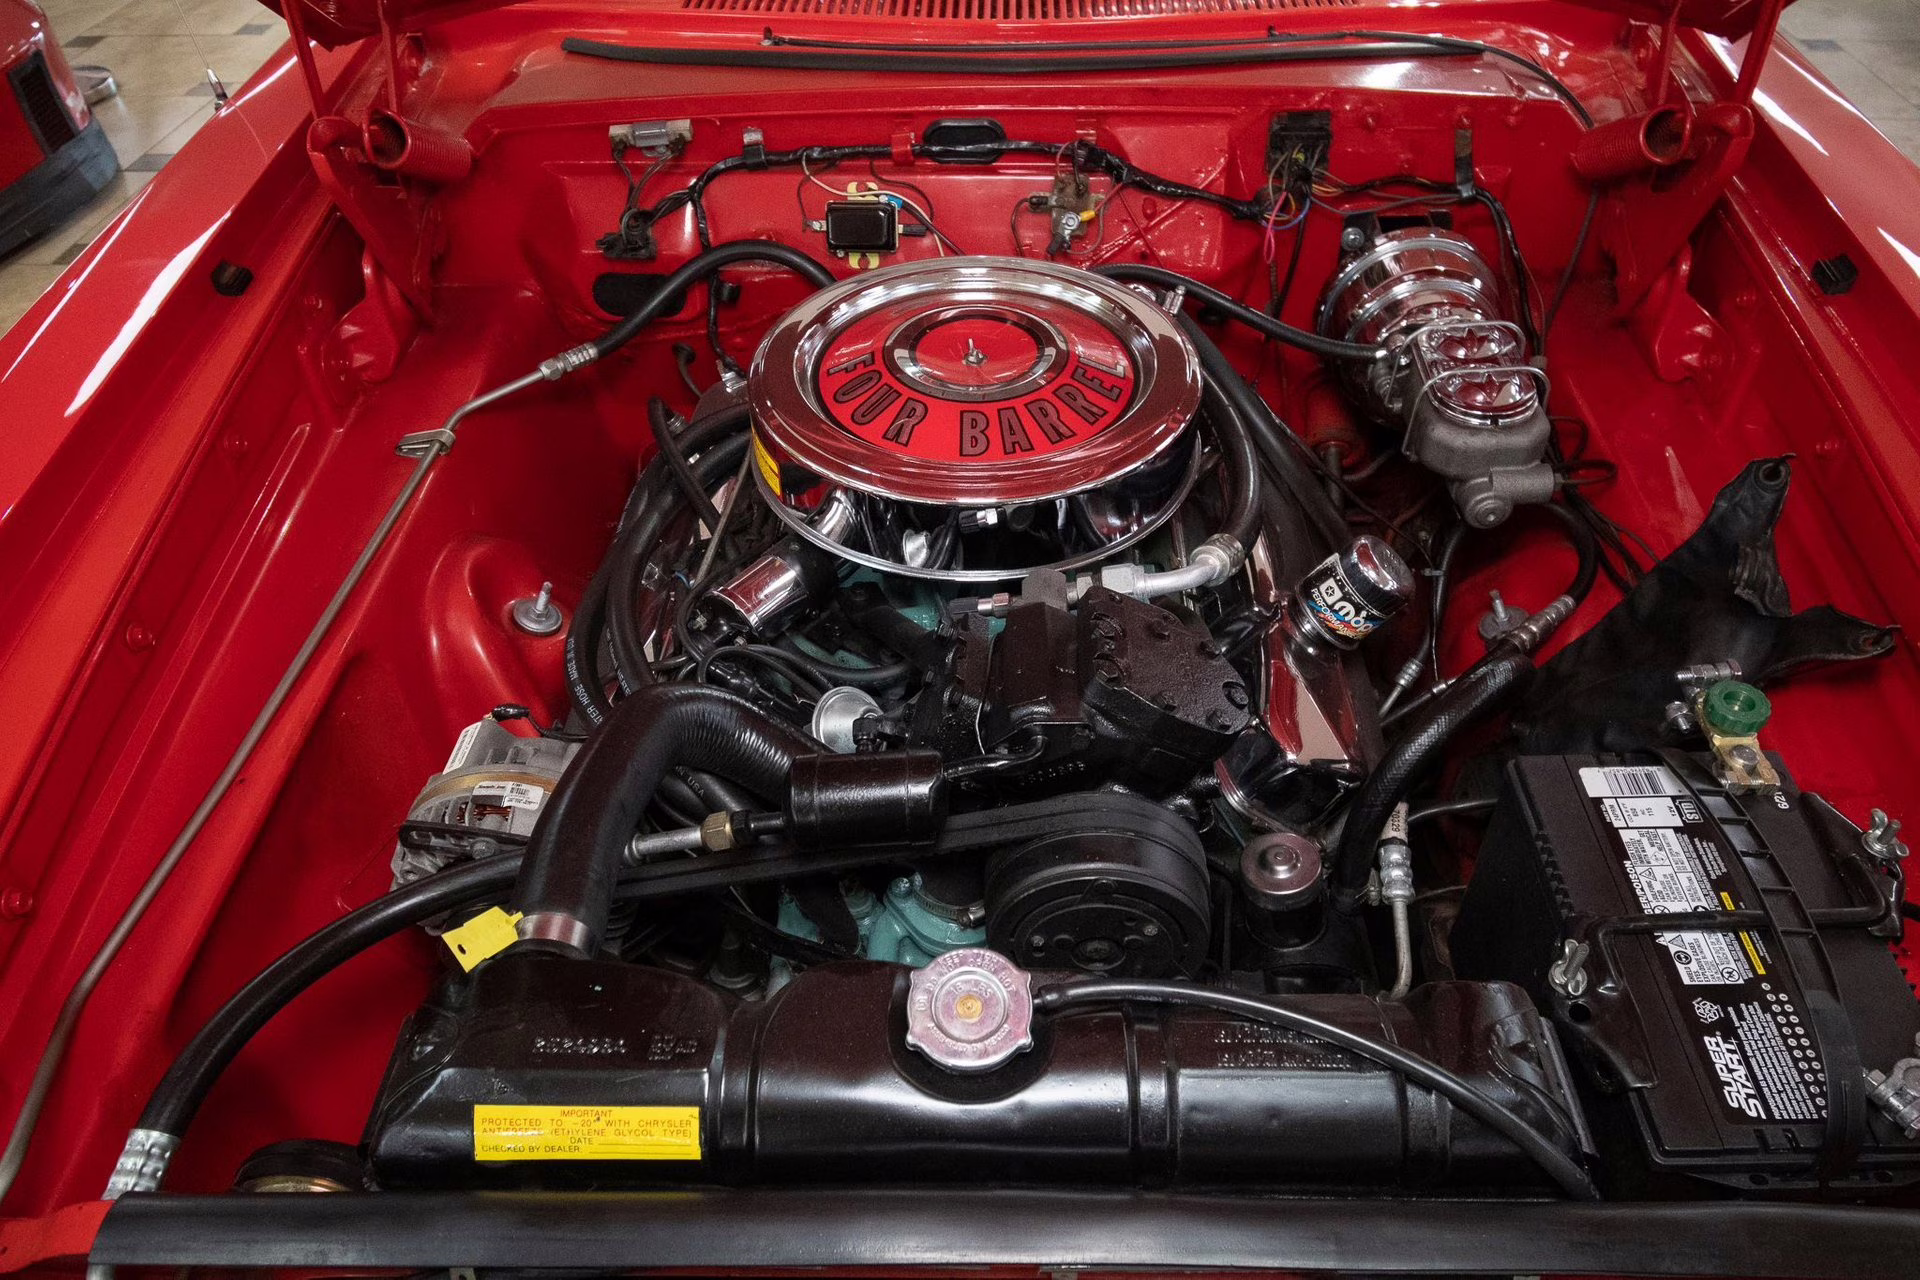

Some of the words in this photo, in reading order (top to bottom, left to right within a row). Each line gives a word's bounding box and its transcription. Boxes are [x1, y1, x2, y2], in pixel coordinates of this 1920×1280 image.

[826, 352, 929, 447] FOUR
[959, 357, 1131, 456] BARREL
[1311, 587, 1357, 639] PERFORMANCE
[567, 660, 579, 681] MADE
[574, 683, 591, 706] HOSE
[586, 704, 603, 726] TER
[1667, 806, 1676, 816] 12V
[1680, 802, 1699, 819] STD
[1623, 861, 1652, 915] GER/POISON
[1687, 942, 1699, 956] GASES
[1683, 966, 1696, 982] SHIELD
[1693, 957, 1711, 981] EXPLOSIVE
[1000, 971, 1016, 992] HOT
[1703, 1035, 1739, 1108] SUPER
[1717, 1036, 1767, 1119] START
[481, 1118, 541, 1127] PROTECTED
[551, 1118, 563, 1127] TO
[605, 1120, 630, 1128] WITH
[638, 1119, 692, 1128] CHRYSLER
[560, 1109, 613, 1118] IMPORTANT
[551, 1128, 606, 1137] (ETHYLENE
[614, 1128, 655, 1137] GLYCOL
[663, 1128, 692, 1138] TYPE)
[570, 1136, 593, 1145] DATE
[482, 1145, 525, 1153] CHECKED
[528, 1145, 541, 1153] BY
